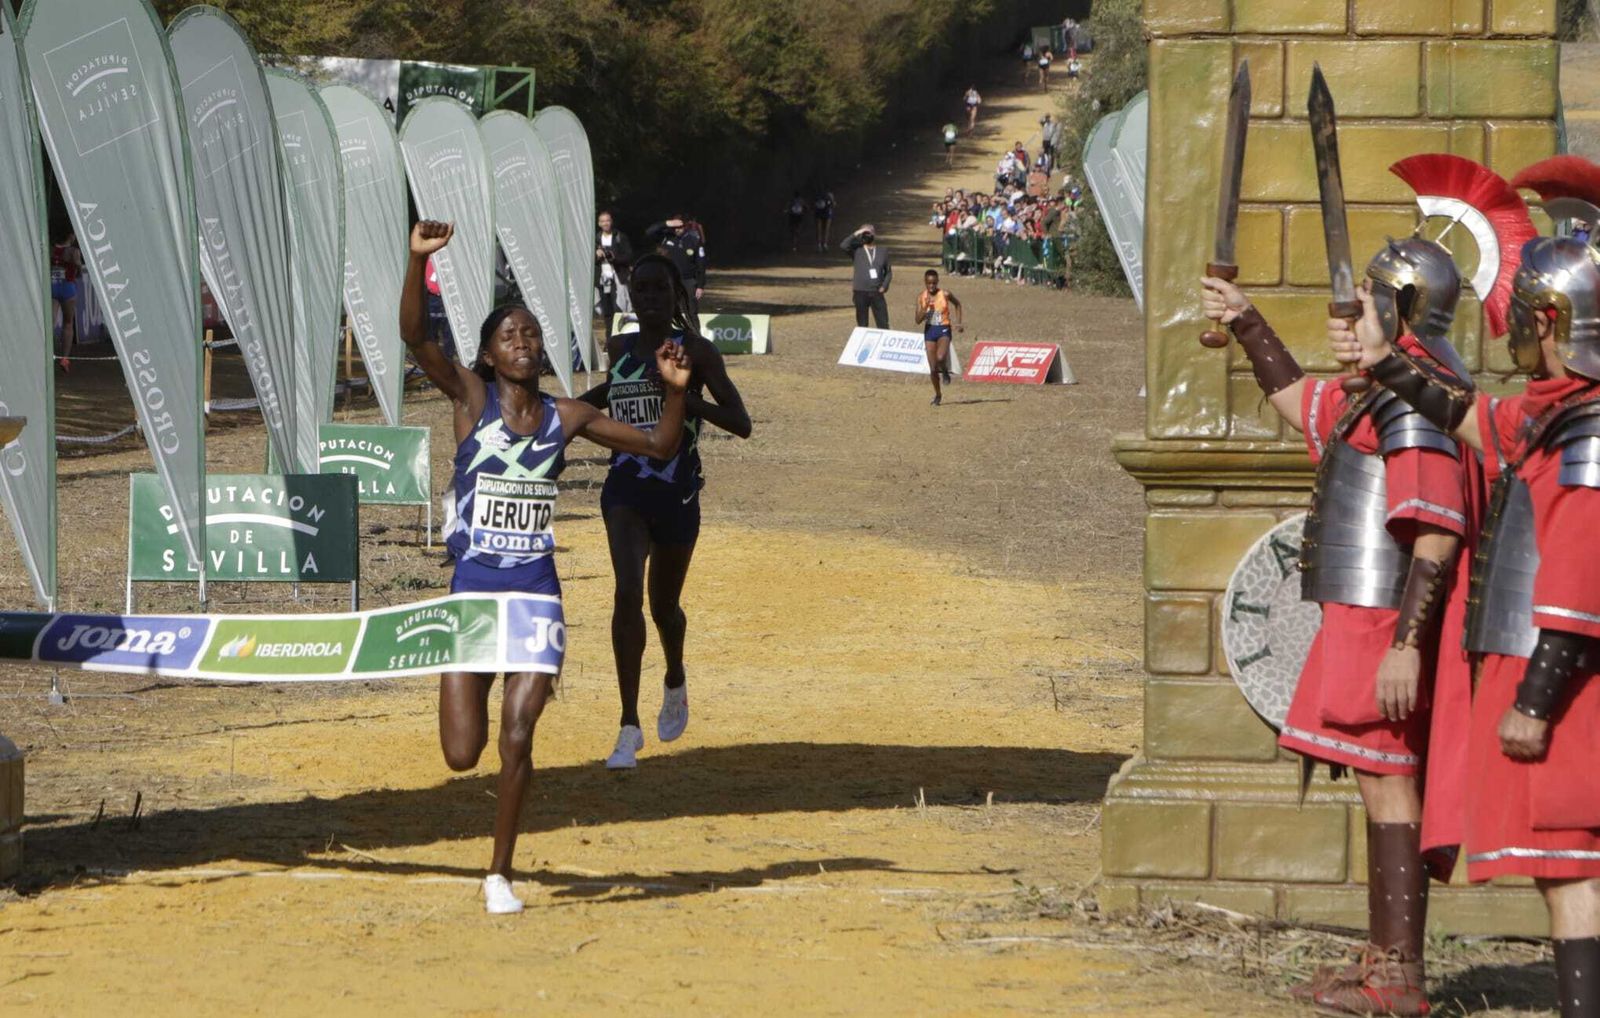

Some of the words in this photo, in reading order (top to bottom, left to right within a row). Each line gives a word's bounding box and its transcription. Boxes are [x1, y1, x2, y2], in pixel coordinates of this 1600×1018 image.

[405, 85, 475, 105] DIPUTACION
[712, 327, 757, 342] ROLA
[319, 439, 395, 461] PUTACION
[342, 466, 356, 474] DE
[358, 481, 396, 494] LLA
[478, 477, 524, 495] DIPUTACION
[524, 484, 534, 495] DE
[159, 486, 326, 523] DUTACION
[480, 499, 550, 532] JERUTO
[230, 529, 254, 544] DE
[254, 641, 343, 658] IBERDROLA
[419, 636, 430, 647] DE
[388, 649, 450, 669] SEVILLA
